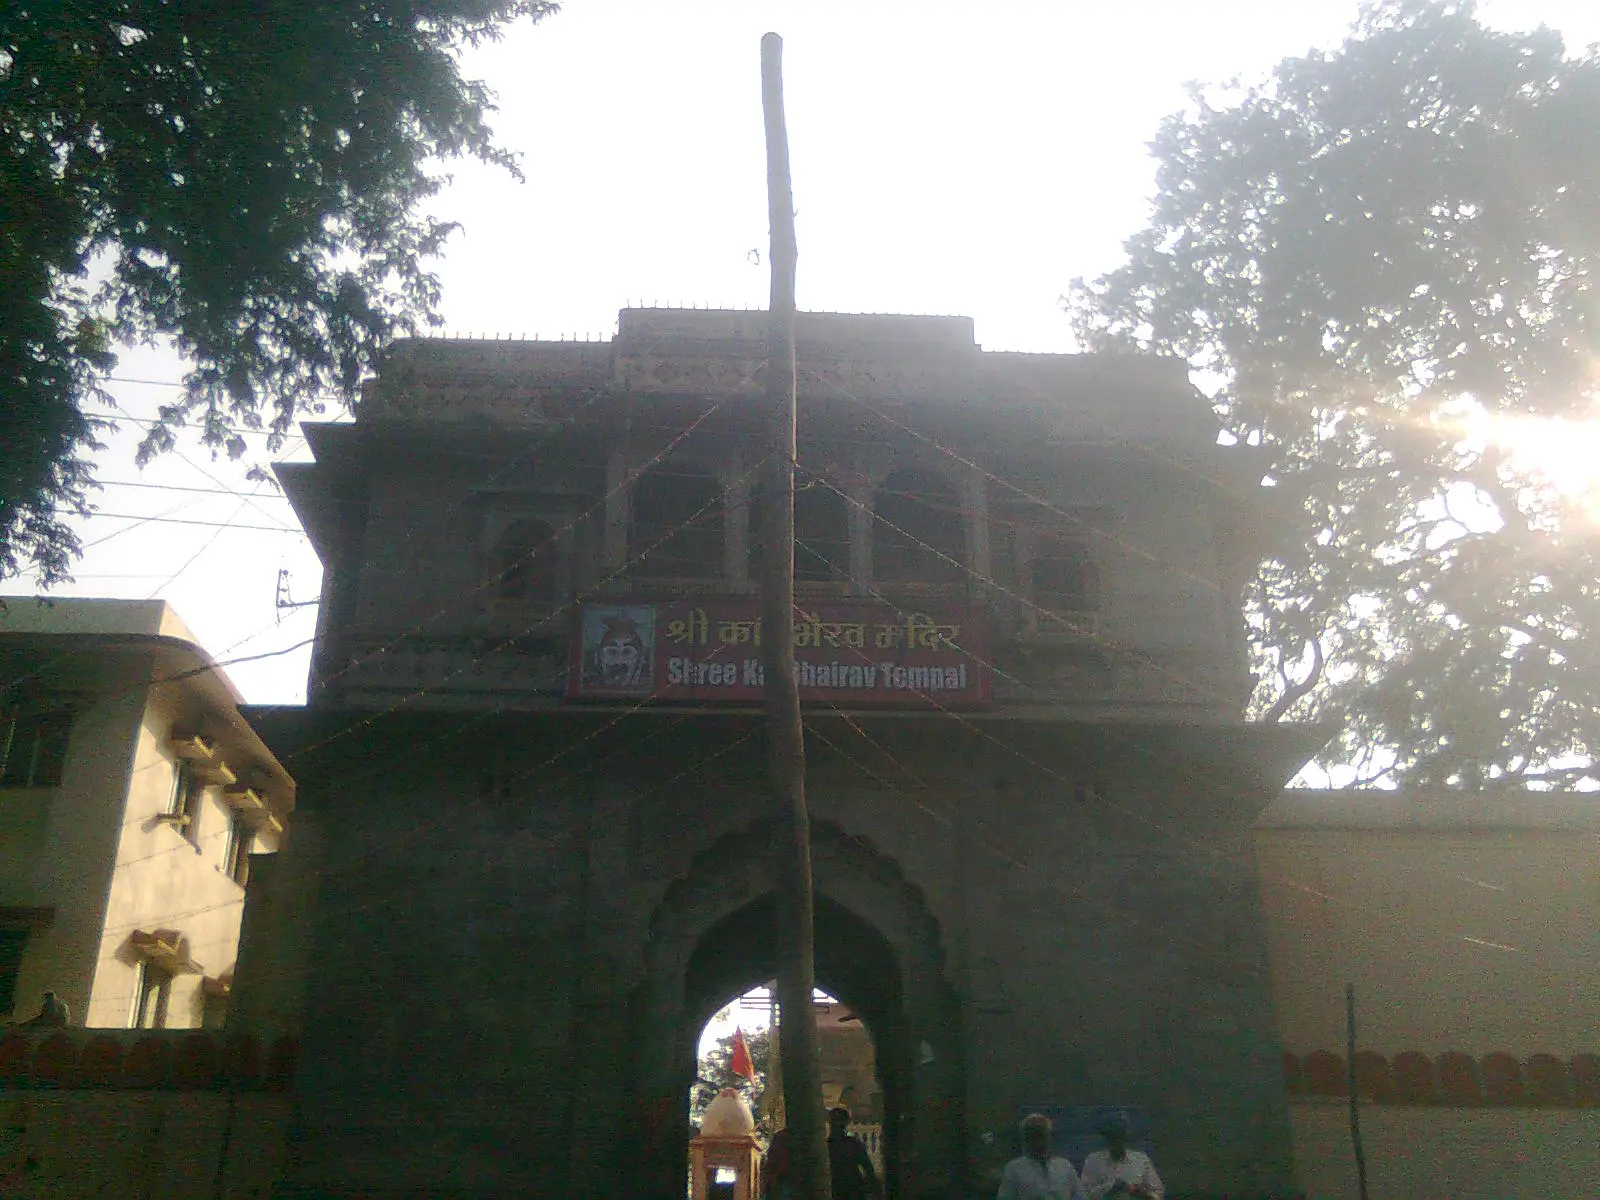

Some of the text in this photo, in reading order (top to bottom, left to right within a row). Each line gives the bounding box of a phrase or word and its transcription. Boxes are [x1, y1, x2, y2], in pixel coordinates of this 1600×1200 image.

[665, 606, 709, 645] श्री
[717, 617, 763, 647] का
[667, 656, 737, 687] Shree
